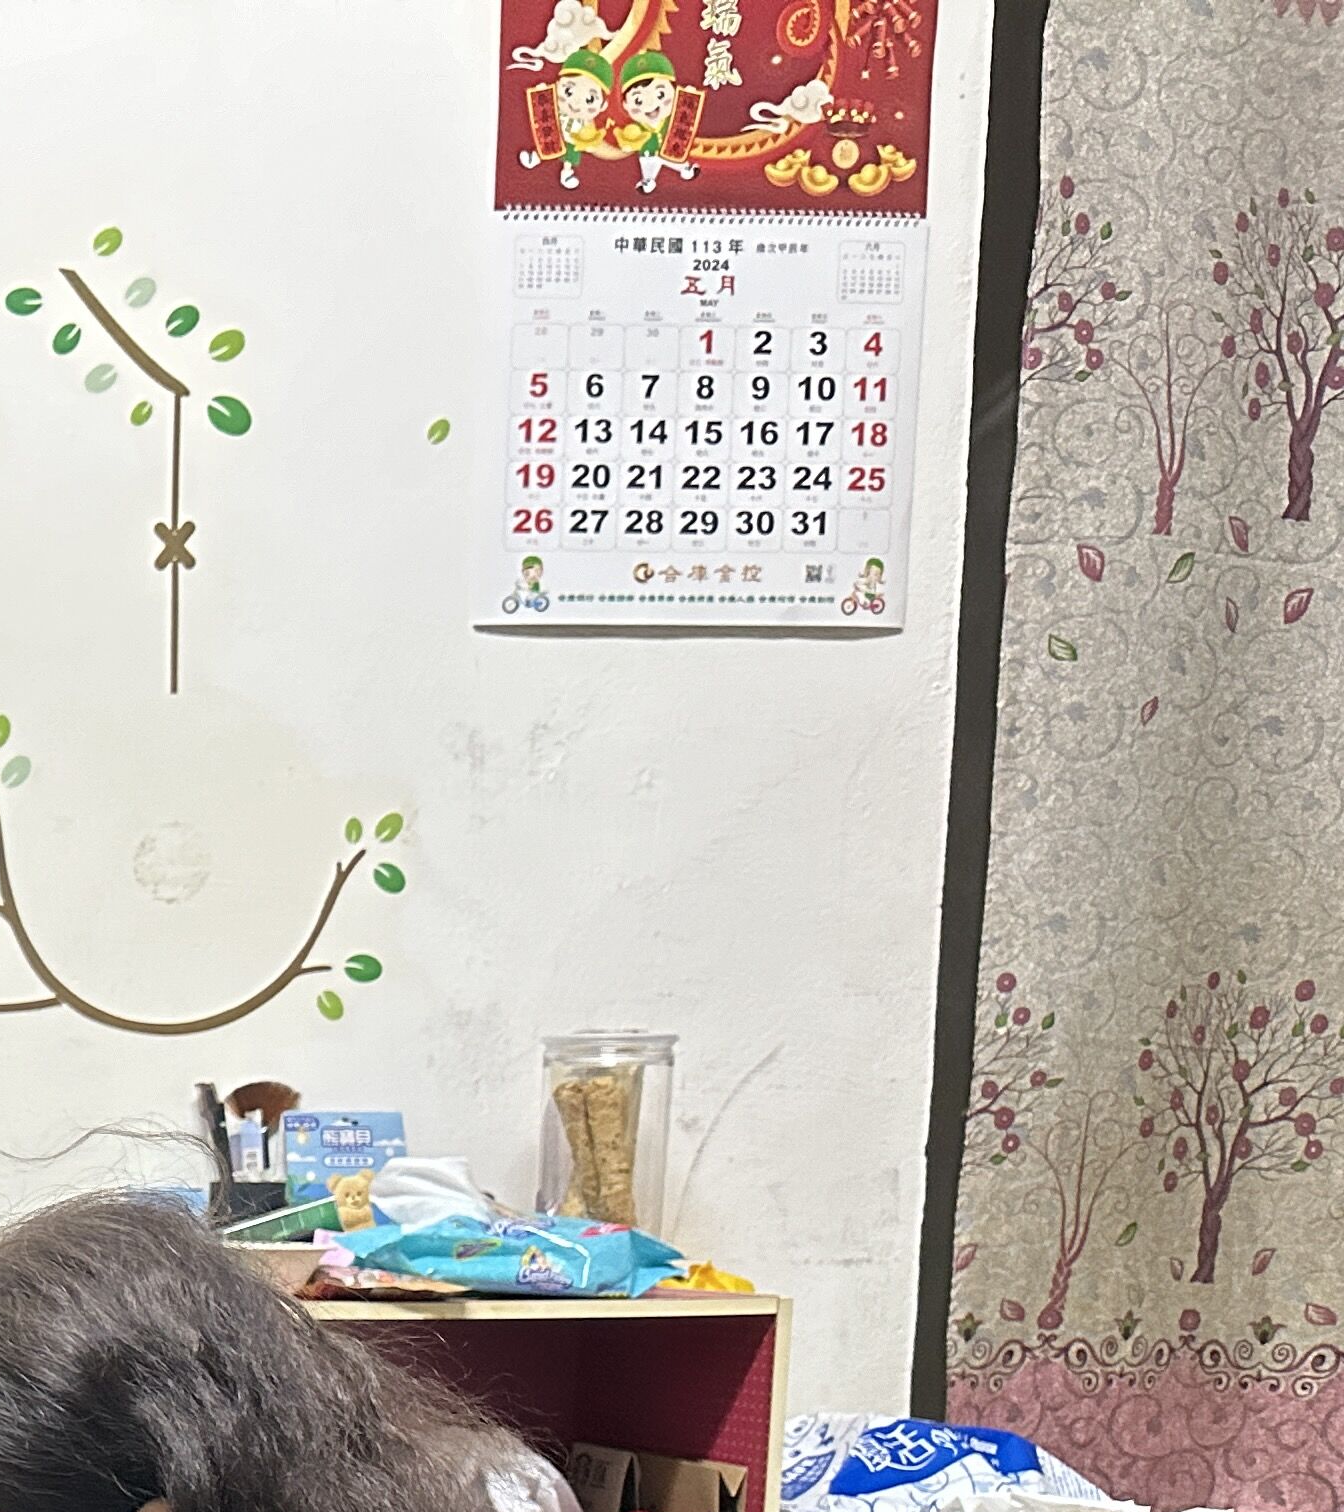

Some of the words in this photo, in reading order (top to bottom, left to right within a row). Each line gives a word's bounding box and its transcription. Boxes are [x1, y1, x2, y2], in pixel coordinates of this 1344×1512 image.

[614, 236, 684, 255] 中華民國
[691, 240, 722, 255] 113
[728, 239, 744, 255] 年
[692, 258, 730, 272] 2024
[679, 275, 736, 296] 五月
[699, 299, 719, 307] MAY
[699, 329, 713, 355] 1
[754, 330, 772, 355] 2
[809, 331, 828, 356] 3
[864, 332, 883, 357] 4
[529, 373, 548, 398] 5
[586, 374, 604, 398] 6
[642, 375, 660, 399] 7
[697, 376, 714, 400] 8
[752, 376, 770, 400] 9
[799, 377, 836, 401] 10
[853, 377, 887, 402] 11
[518, 418, 557, 444] 12
[574, 419, 612, 444] 13
[630, 420, 668, 445] 14
[685, 421, 723, 445] 15
[741, 421, 779, 446] 16
[797, 422, 835, 446] 17
[852, 422, 888, 448] 18
[516, 464, 555, 489] 19
[572, 464, 611, 489] 20
[626, 465, 662, 490] 21
[682, 466, 721, 490] 22
[737, 466, 776, 491] 23
[793, 467, 832, 491] 24
[847, 467, 886, 492] 25
[513, 509, 553, 534] 26
[569, 510, 609, 534] 27
[624, 510, 664, 535] 28
[679, 511, 719, 535] 29
[735, 511, 775, 536] 30
[791, 512, 827, 536] 31
[658, 564, 763, 583] 合庫金控
